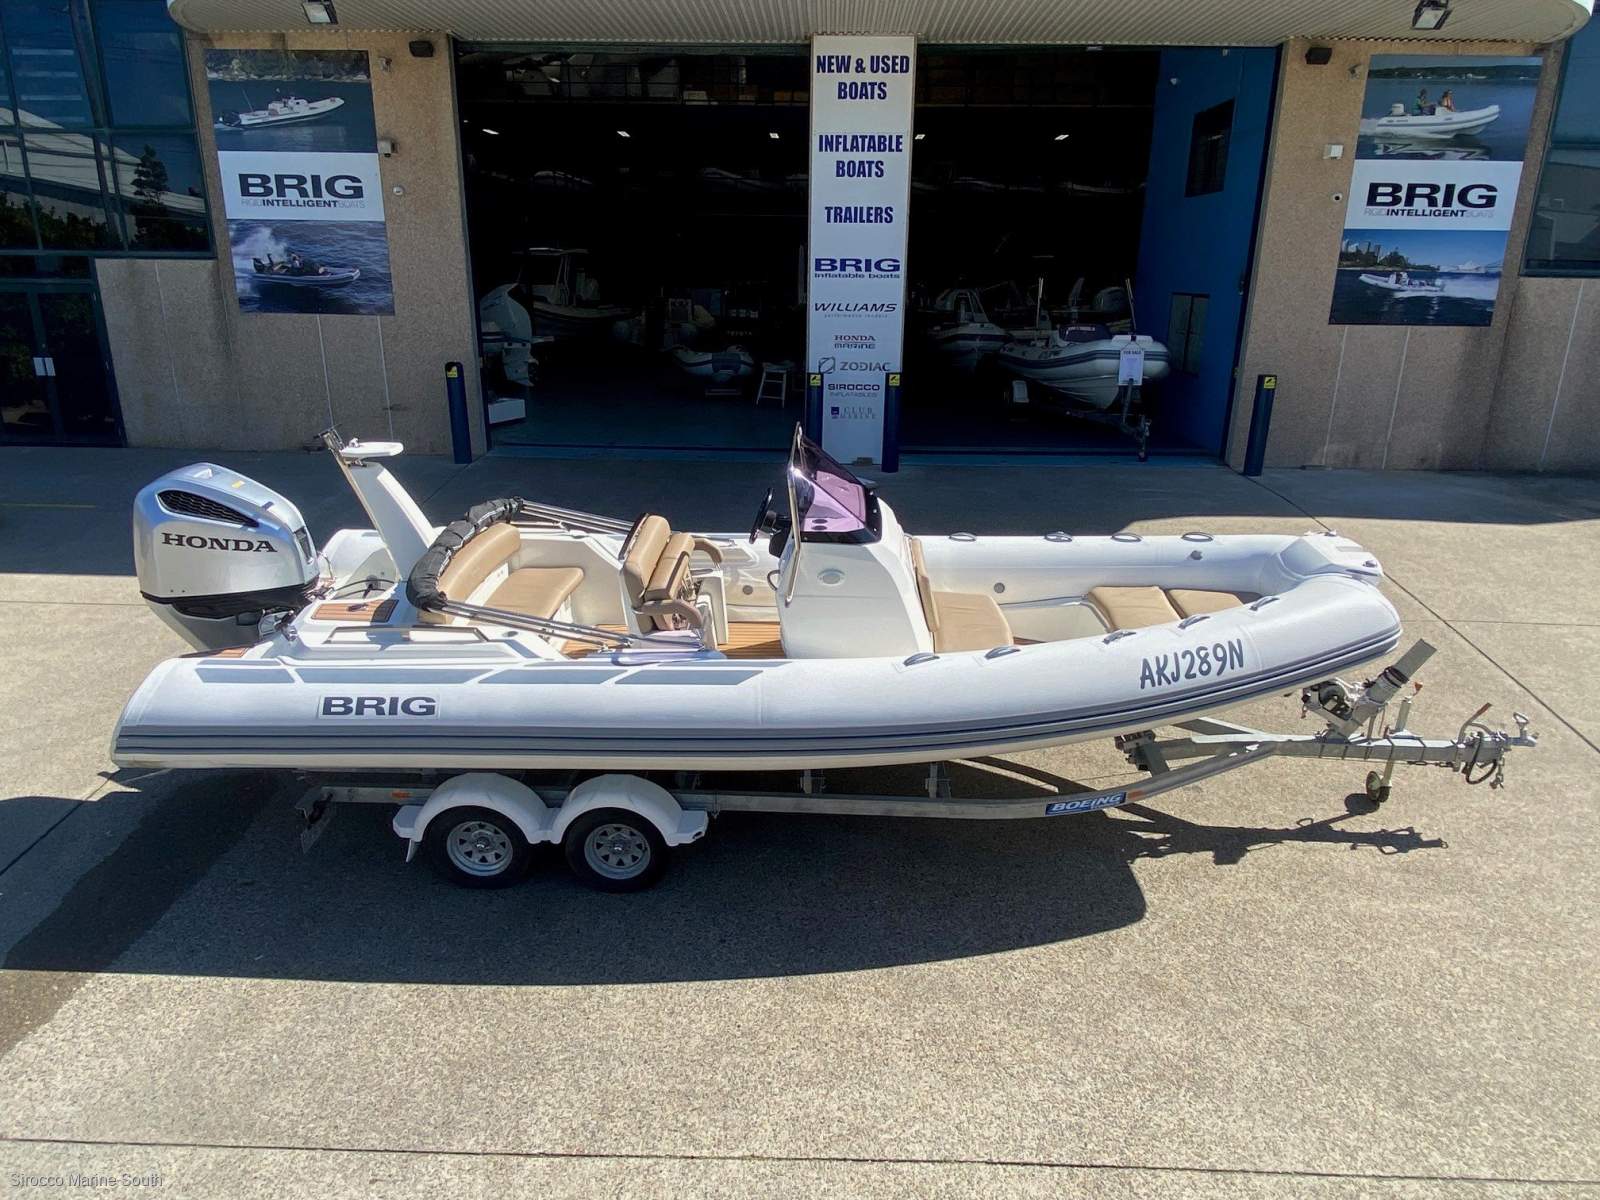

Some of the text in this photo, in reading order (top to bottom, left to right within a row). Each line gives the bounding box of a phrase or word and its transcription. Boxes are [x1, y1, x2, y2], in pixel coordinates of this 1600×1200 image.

[816, 55, 910, 74] NEW & USED
[837, 82, 887, 100] BOATS
[818, 135, 903, 152] INFLATABLE
[835, 160, 885, 178] BOATS
[238, 173, 364, 200] BRIG
[1366, 182, 1498, 209] BRIG
[825, 206, 894, 224] TRAILERS
[814, 258, 900, 272] BRIG
[814, 302, 897, 313] WILLIAMS
[840, 361, 891, 372] ZODIAC
[161, 532, 278, 553] HONDA
[1140, 638, 1244, 690] AKJ289N
[322, 696, 437, 716] BRIG
[1052, 794, 1121, 811] BOEING
